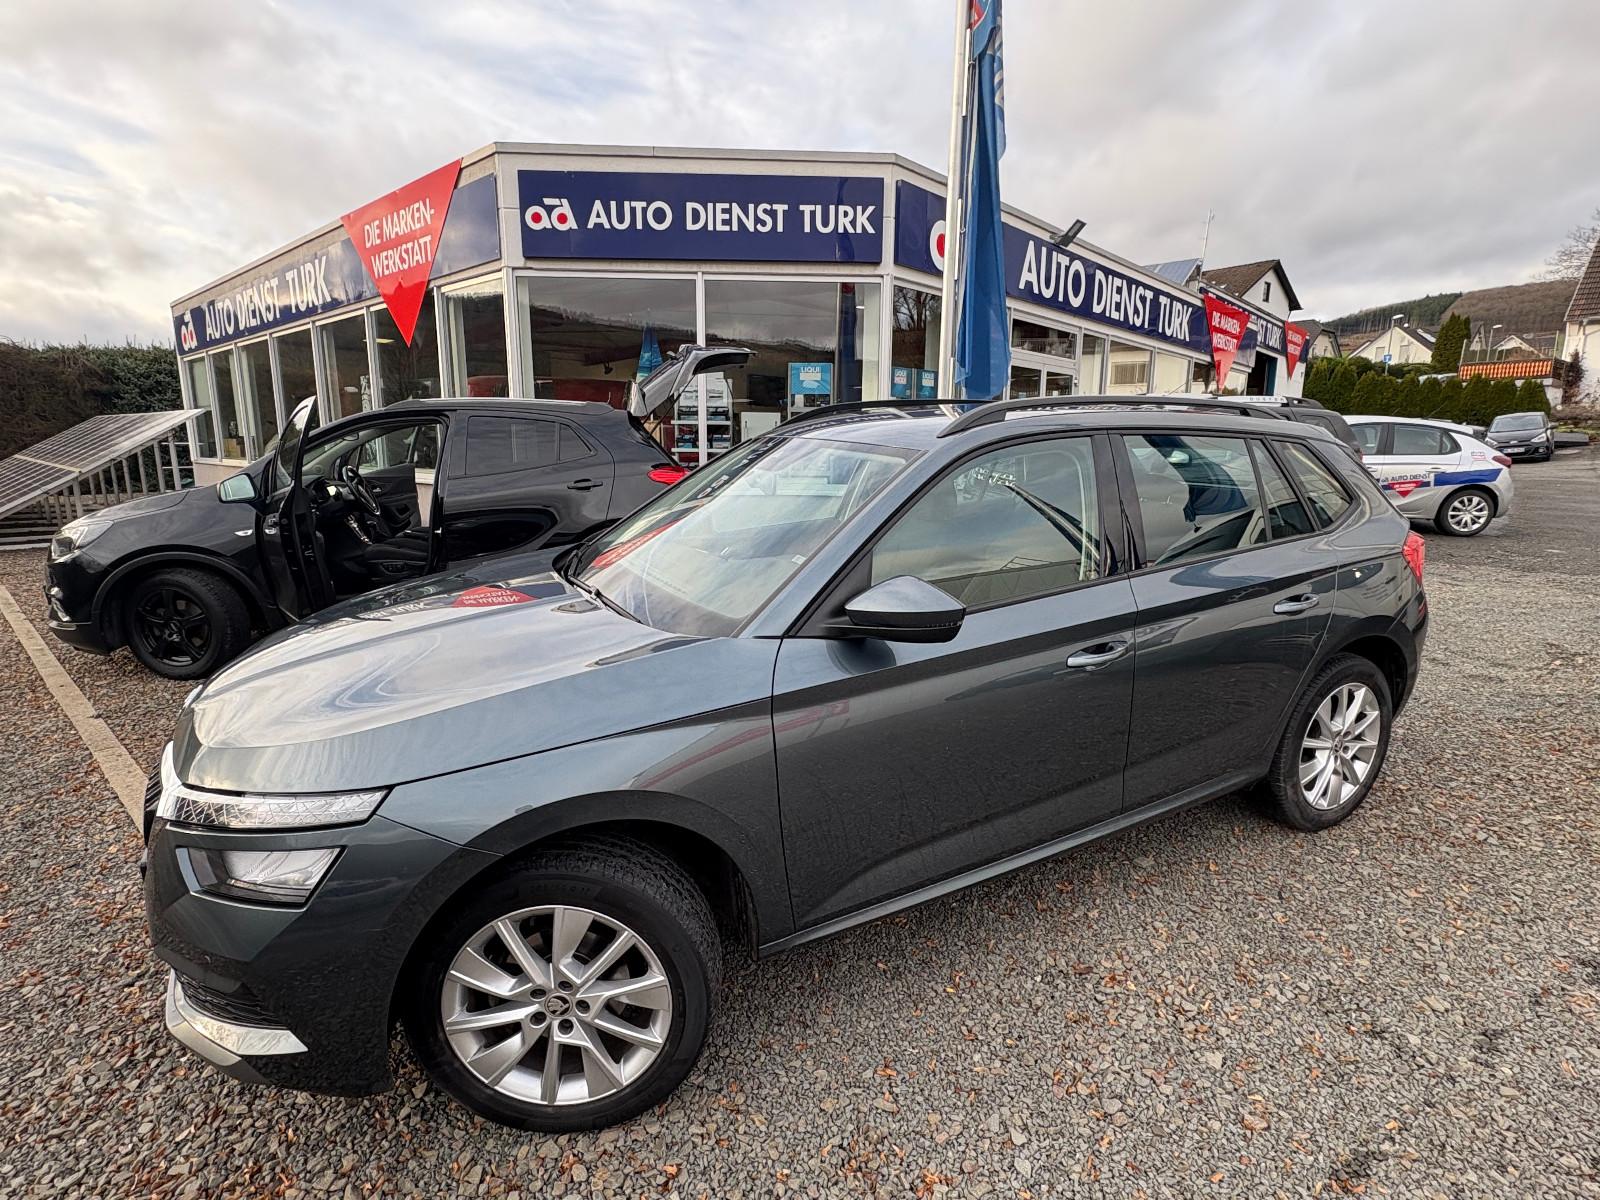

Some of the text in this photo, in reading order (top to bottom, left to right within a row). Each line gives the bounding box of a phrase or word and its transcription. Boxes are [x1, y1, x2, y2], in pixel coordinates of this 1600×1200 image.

[364, 198, 435, 249] DIE MARKEN-
[587, 200, 673, 231] AUTO
[686, 202, 788, 233] DIENST
[799, 204, 876, 234] TURK
[371, 234, 432, 279] WERKSTATT
[205, 300, 235, 341] AUTO
[235, 277, 280, 331] DIENST
[286, 255, 332, 314] TURK
[1018, 239, 1086, 308] AUTO
[1092, 269, 1153, 329] DIENST
[1158, 295, 1193, 342] TURK
[1266, 322, 1282, 350] TURK
